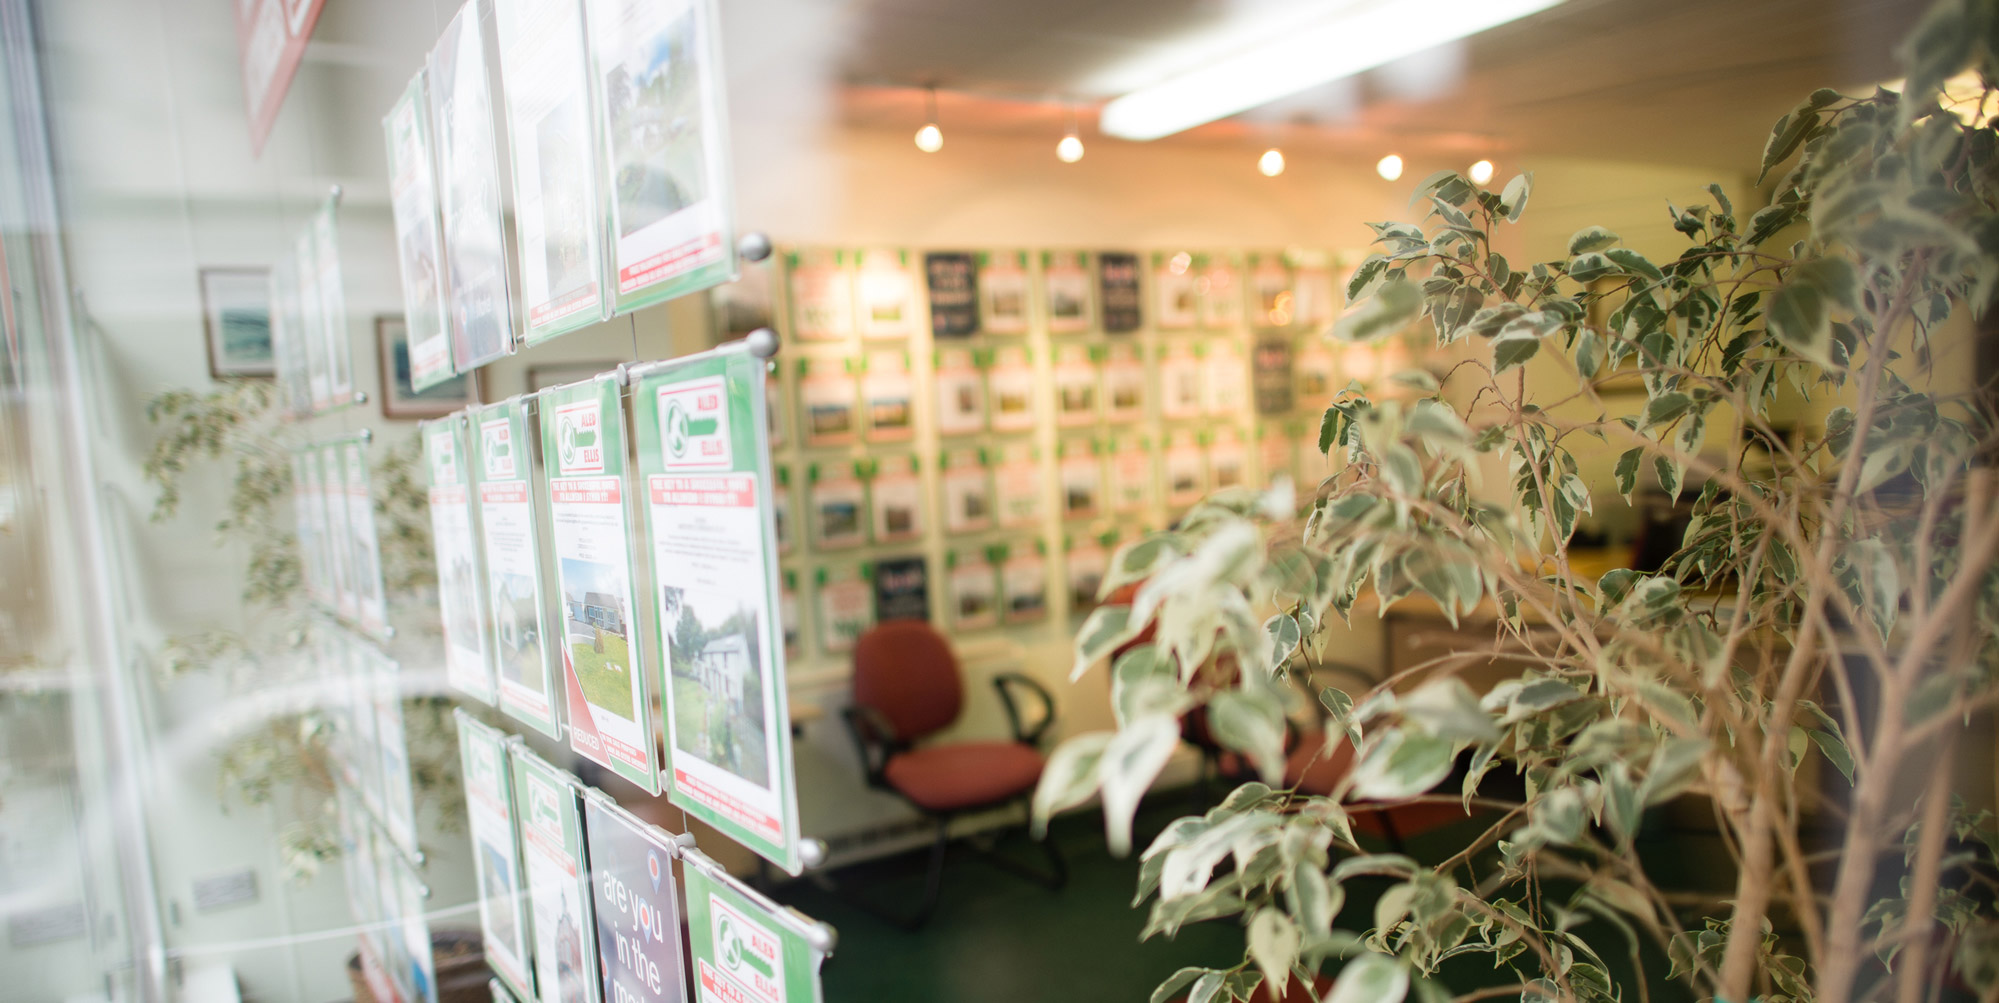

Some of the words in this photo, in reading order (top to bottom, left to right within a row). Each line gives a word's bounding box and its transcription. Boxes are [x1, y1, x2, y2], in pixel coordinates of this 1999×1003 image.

[581, 412, 597, 428] ALED
[583, 448, 600, 464] ELLIS
[573, 726, 600, 751] REDUCED
[602, 869, 628, 914] are
[628, 888, 664, 944] you
[614, 920, 631, 970] in
[631, 937, 662, 996] the
[752, 934, 775, 960] ALED
[755, 974, 778, 1001] ELLIS
